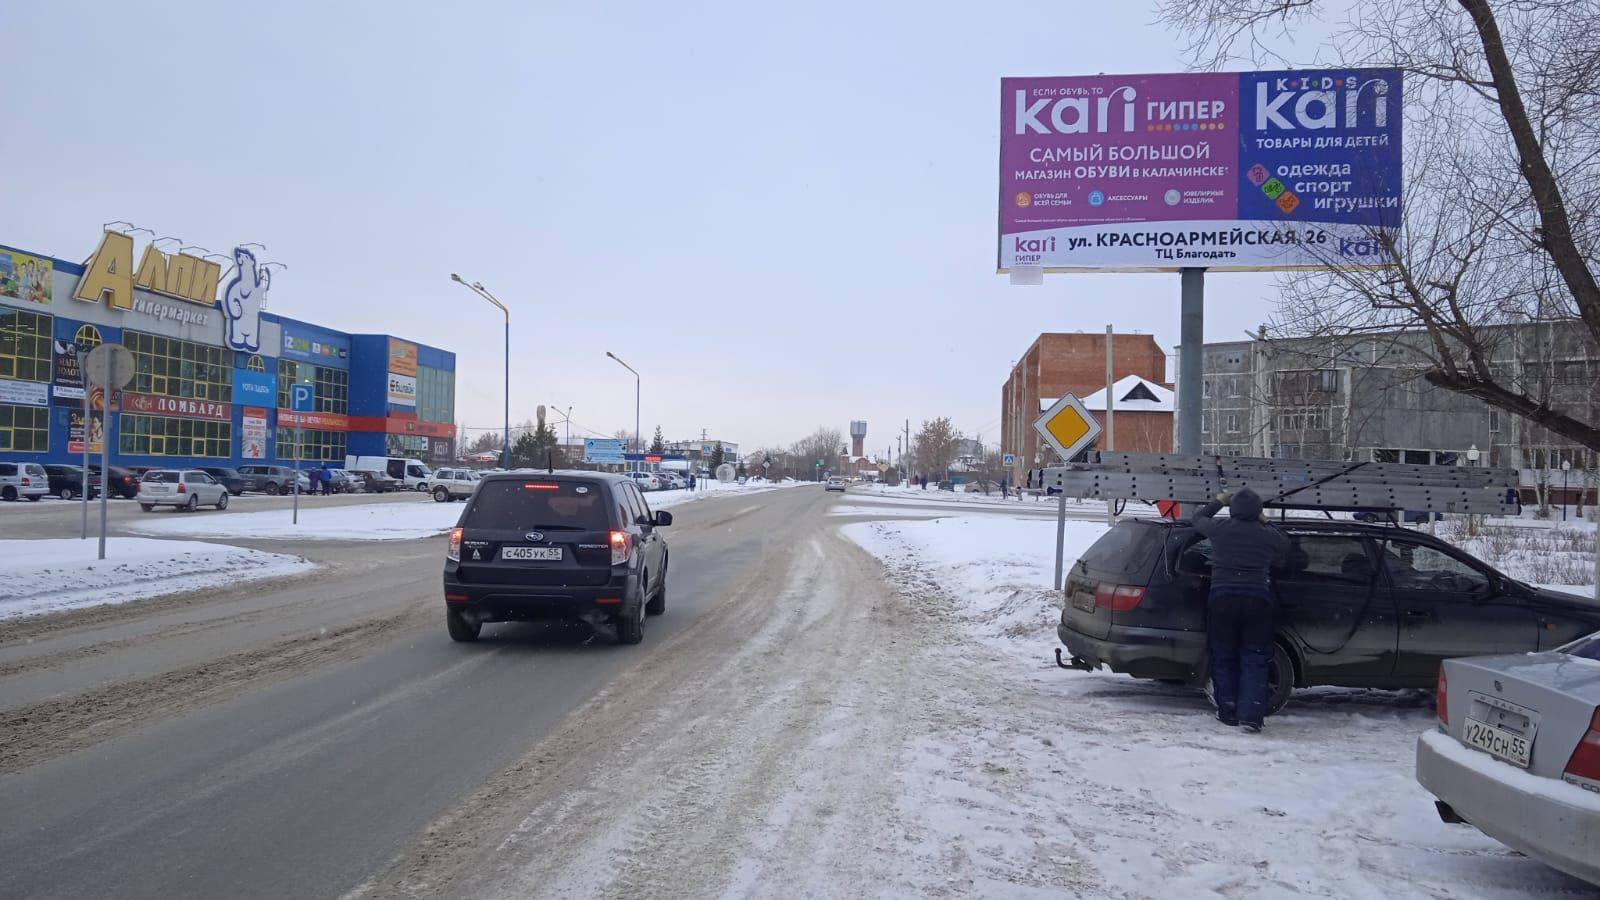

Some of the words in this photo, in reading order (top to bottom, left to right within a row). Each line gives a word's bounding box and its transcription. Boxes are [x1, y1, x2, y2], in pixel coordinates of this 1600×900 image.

[1033, 88, 1057, 96] ЕСЛИ
[1060, 87, 1090, 96] ОБУВЬ,
[1092, 87, 1104, 95] ТО
[1015, 86, 1137, 135] kari
[1147, 100, 1225, 120] ГИПЕР
[1256, 78, 1389, 131] kari
[1256, 137, 1312, 149] ТОВАРЫ
[1314, 137, 1342, 148] ДЛЯ
[1345, 134, 1389, 148] ДЕТЕЙ
[1030, 144, 1103, 163] САМЫЙ
[1109, 141, 1210, 161] БОЛЬШОЙ
[1015, 169, 1071, 180] МАГАЗИН
[1074, 166, 1130, 179] ОБУВИ
[1277, 163, 1351, 178] одежда
[1055, 192, 1068, 200] ДЛЯ
[1295, 181, 1352, 196] спорт
[1314, 196, 1398, 213] игрушки
[1015, 236, 1056, 252] kari
[1069, 238, 1092, 250] ул.
[1306, 230, 1327, 245] 26
[1155, 248, 1173, 260] ТЦ
[1176, 249, 1236, 260] Благодать
[133, 298, 209, 327] гипермаркет
[295, 387, 309, 410] P
[158, 398, 223, 418] ЛОМБАРД
[1512, 737, 1526, 756] 55
